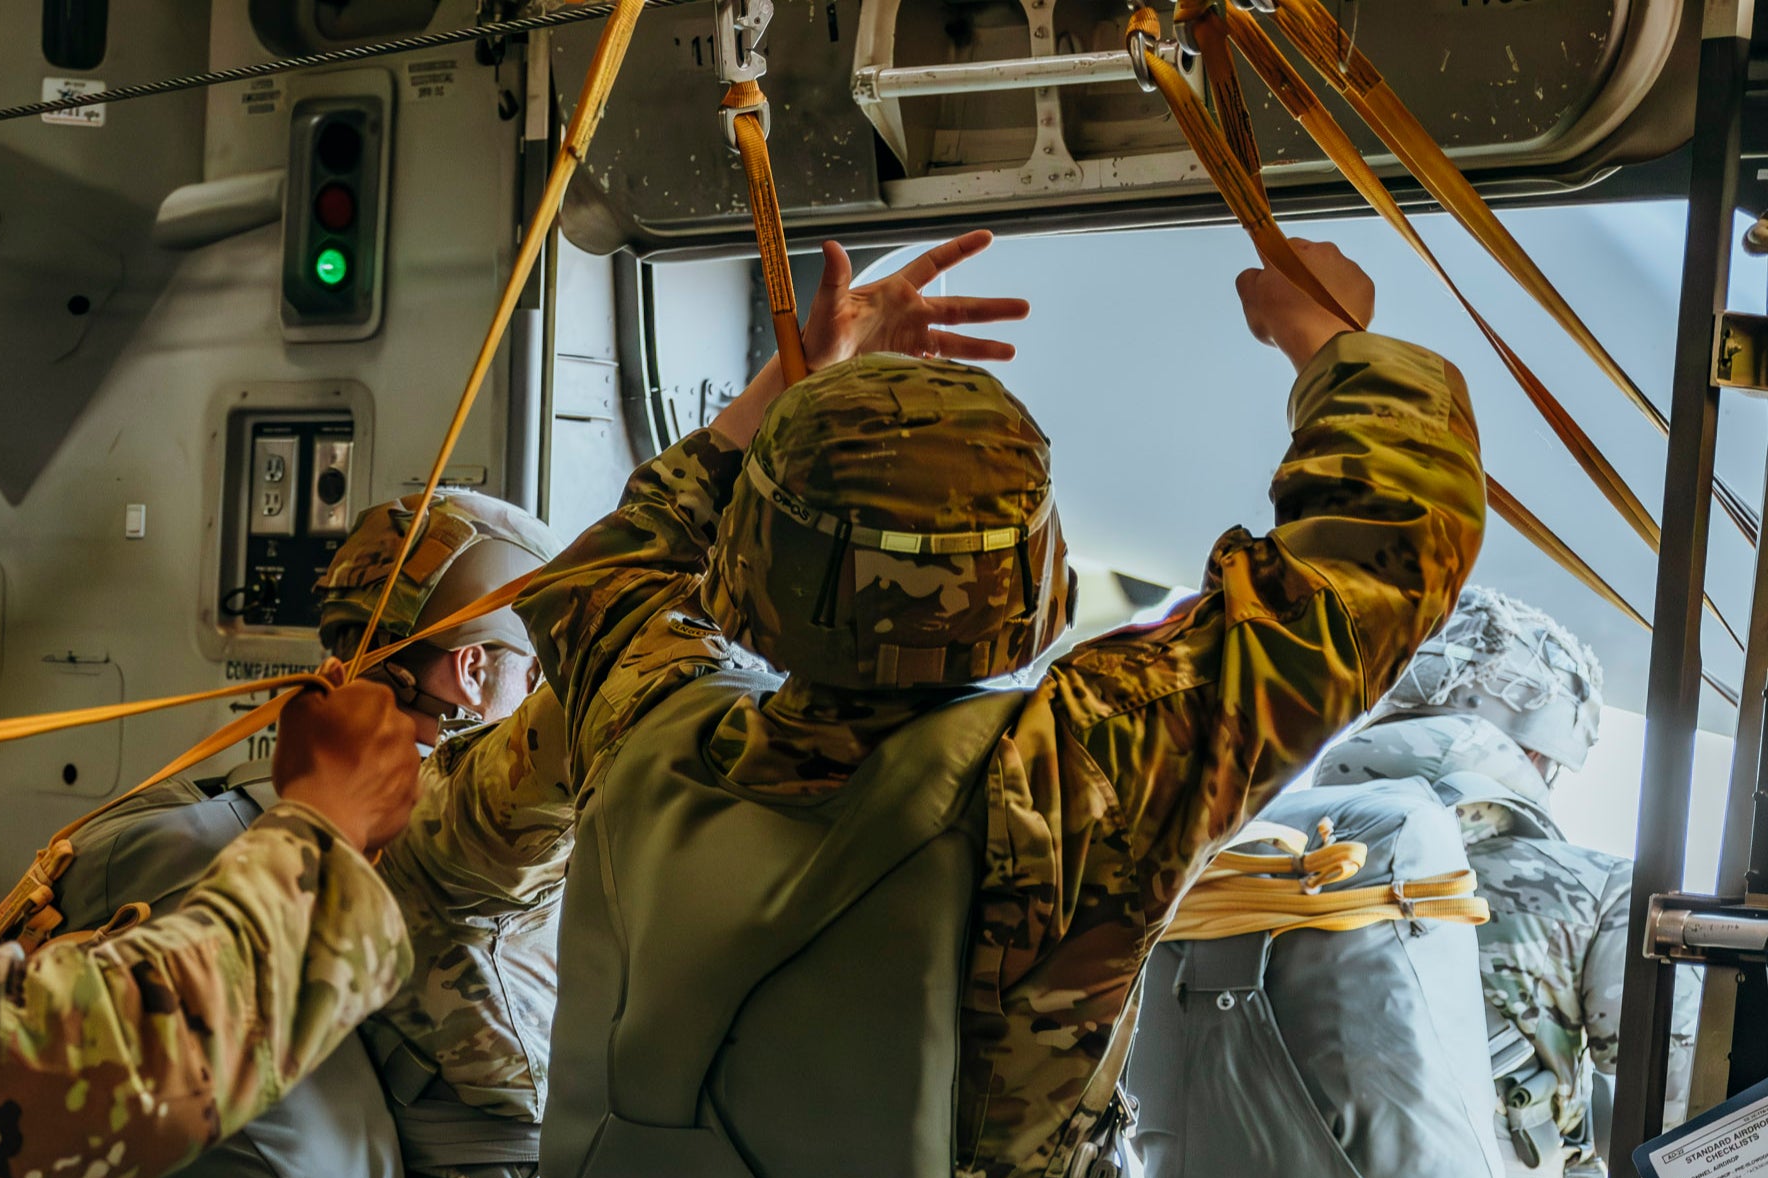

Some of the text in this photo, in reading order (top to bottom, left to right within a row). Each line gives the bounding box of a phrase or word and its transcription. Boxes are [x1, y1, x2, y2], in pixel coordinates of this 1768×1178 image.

[1685, 1136, 1731, 1164] STANDARD
[1705, 1133, 1760, 1163] CHECKLISTS
[1713, 1155, 1740, 1172] AIRDROP
